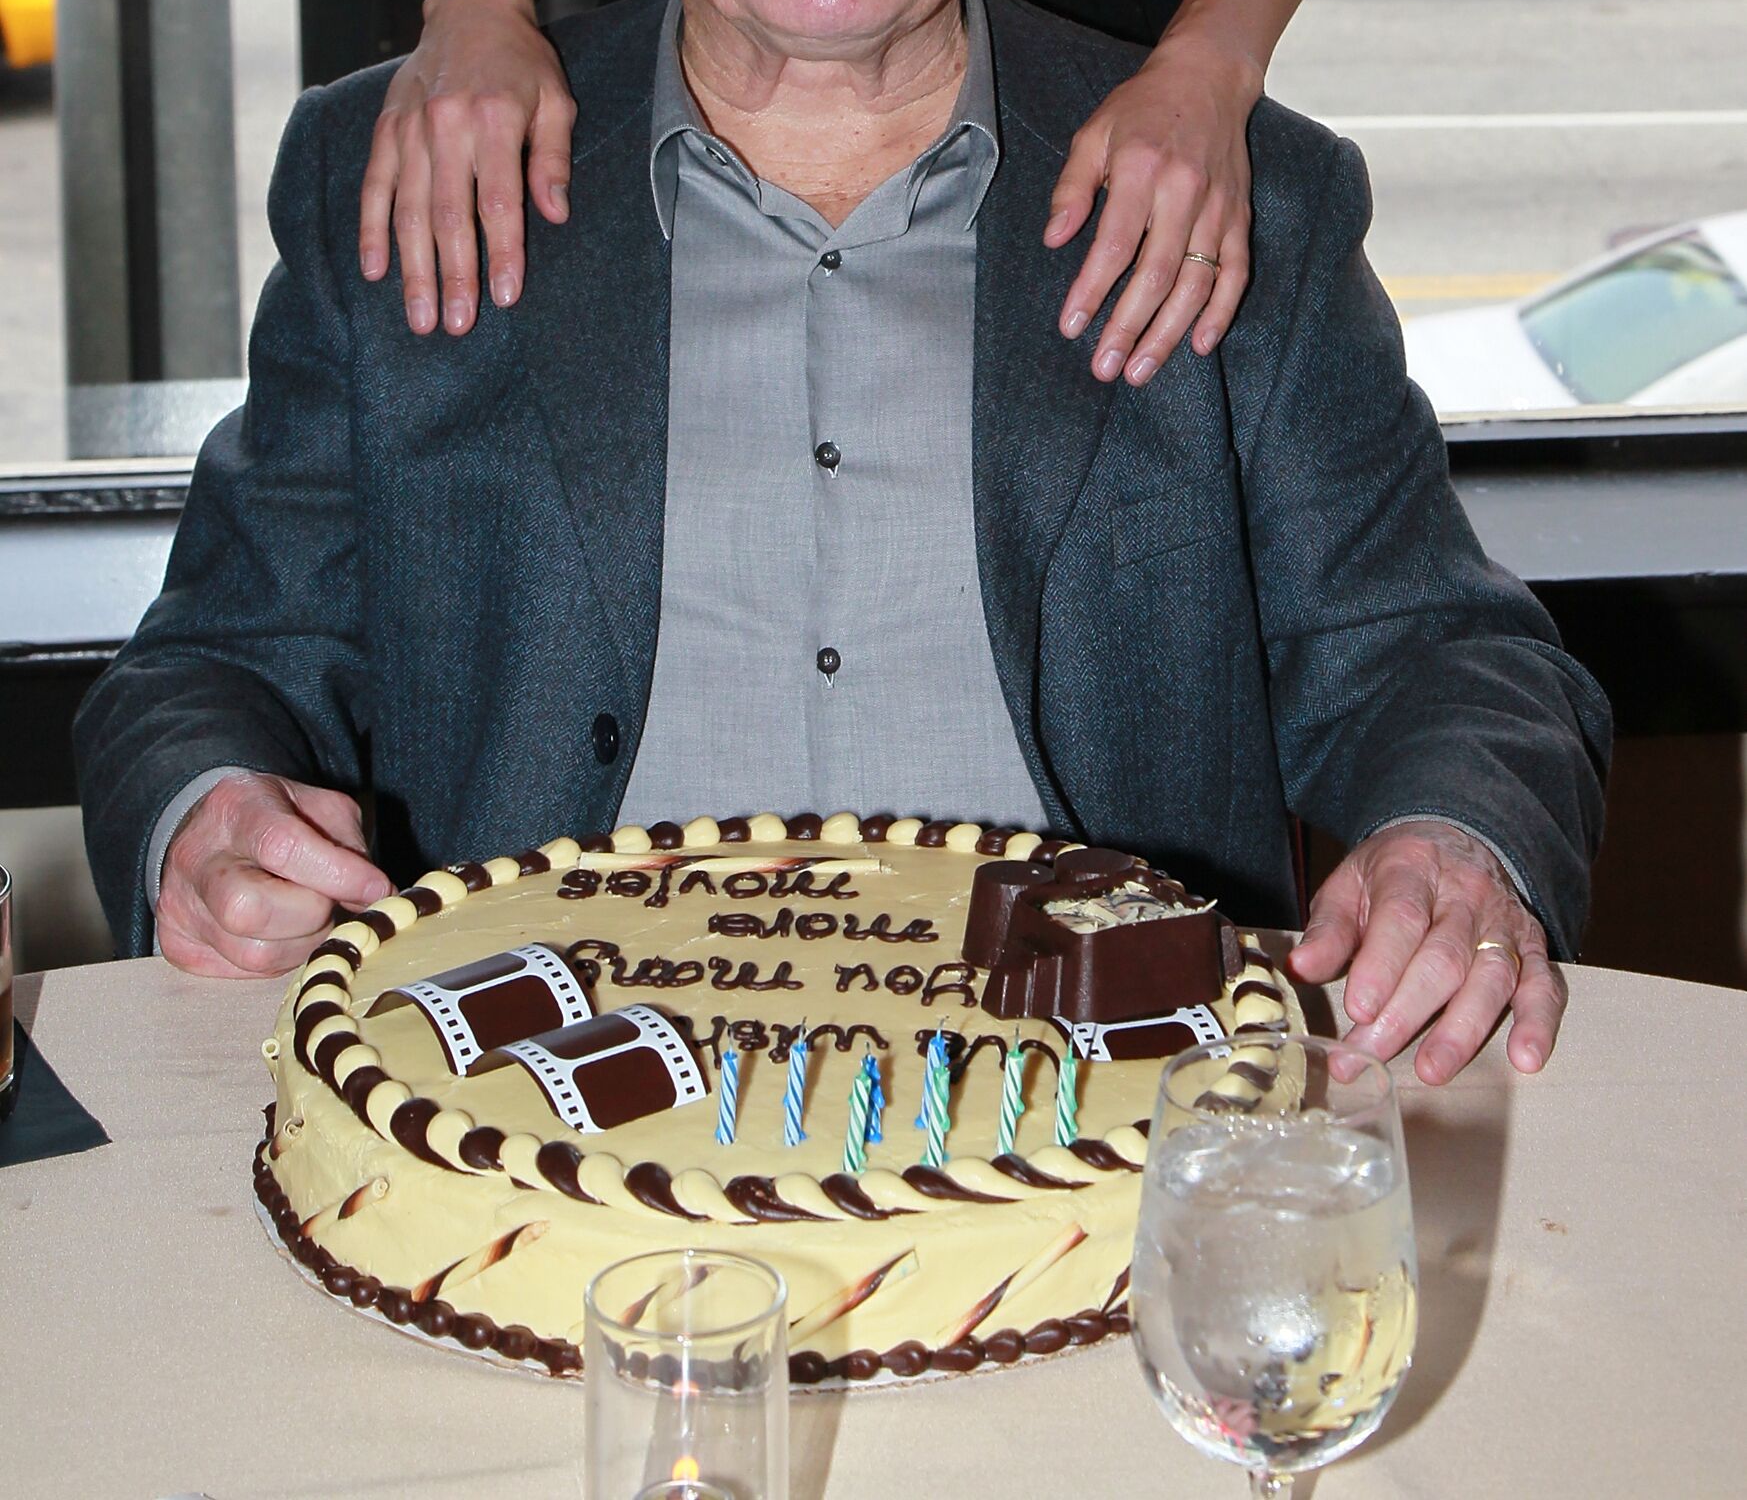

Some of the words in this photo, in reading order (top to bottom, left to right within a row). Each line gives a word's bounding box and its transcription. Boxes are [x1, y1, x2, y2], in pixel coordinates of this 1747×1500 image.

[556, 866, 860, 910] movies
[706, 907, 940, 944] more
[564, 939, 804, 994] many
[668, 1015, 889, 1070] wish
